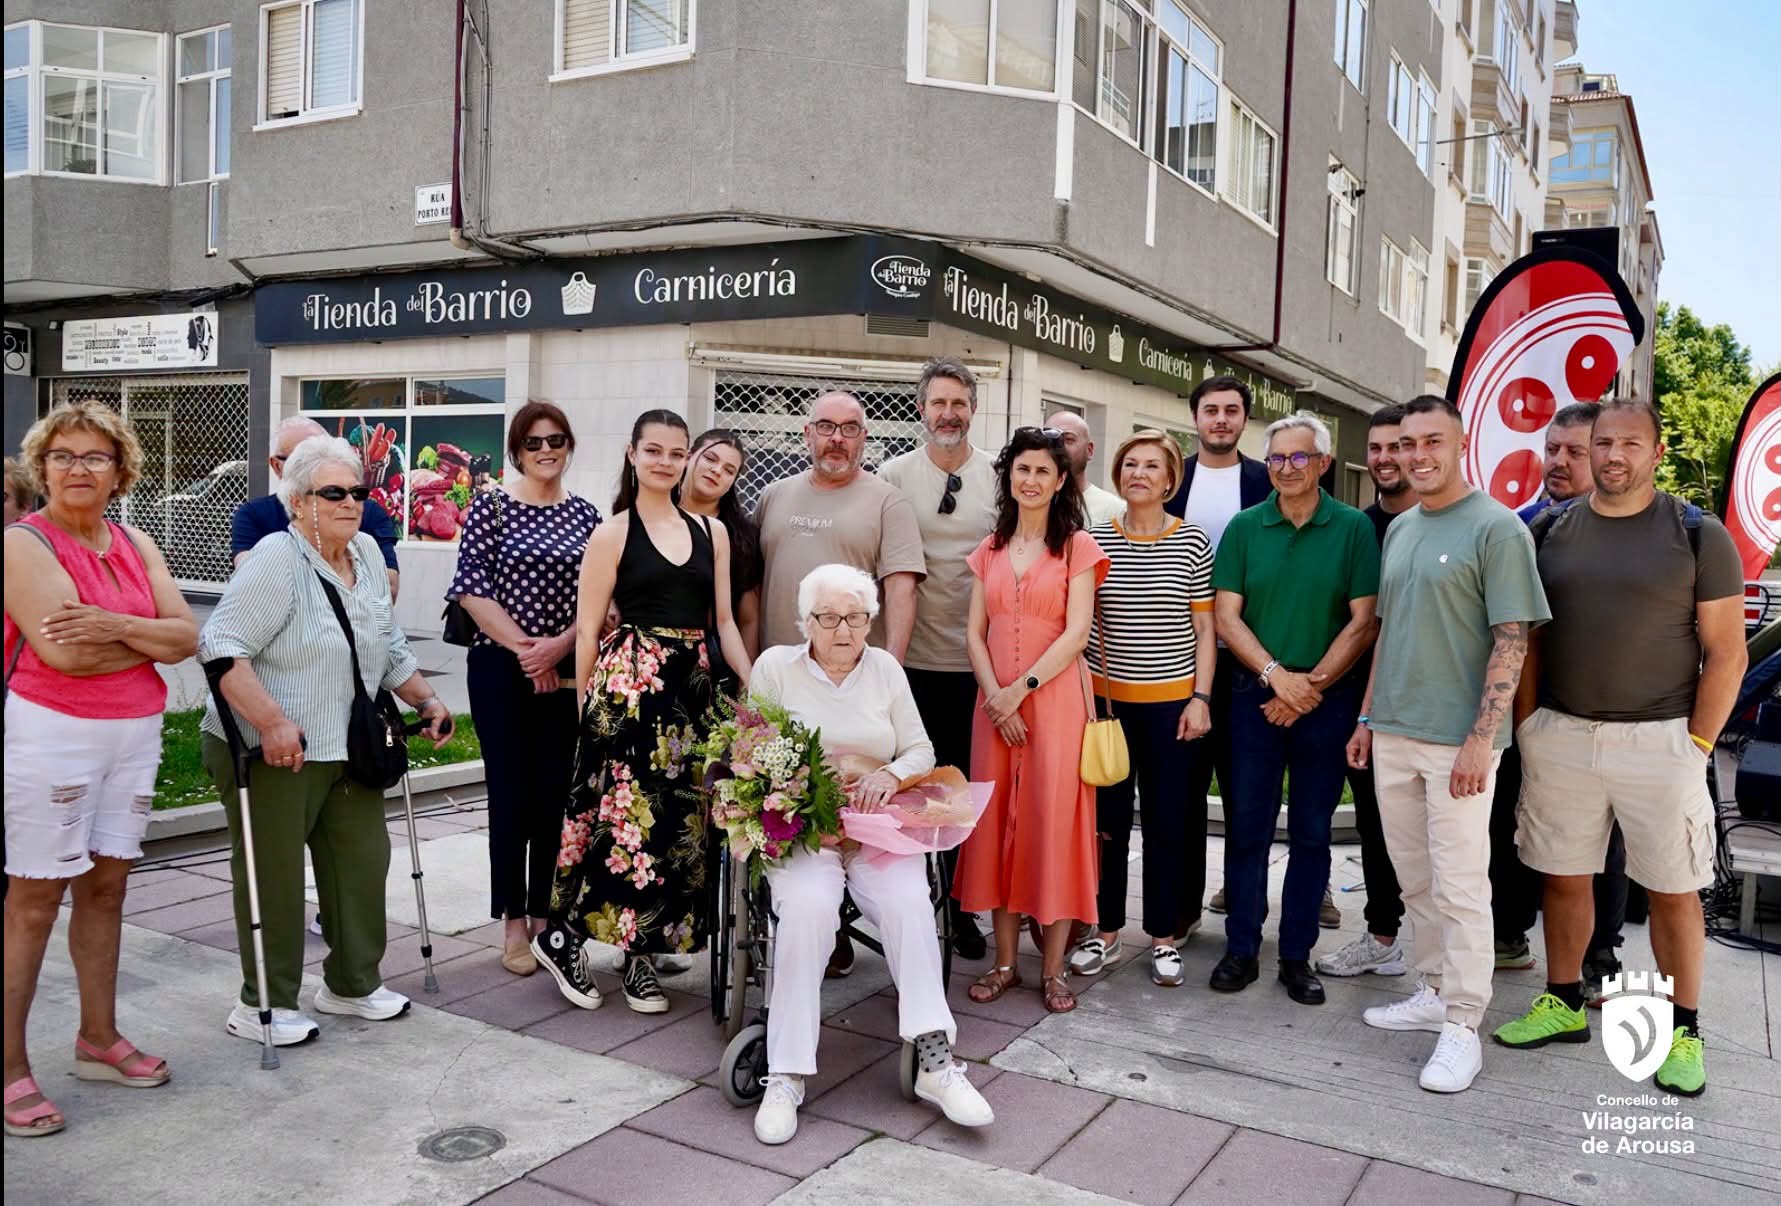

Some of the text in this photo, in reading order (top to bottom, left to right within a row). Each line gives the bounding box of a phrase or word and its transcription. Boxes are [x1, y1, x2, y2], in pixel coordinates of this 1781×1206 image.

[417, 206, 451, 219] PORTO RE
[634, 258, 796, 304] Carnicería
[883, 268, 927, 287] Barrio
[889, 260, 931, 278] Tienda
[303, 279, 532, 330] la Tienda del Barrio
[943, 266, 1096, 354] la Tienda del Barrio
[1138, 336, 1193, 382] Carnicería
[1263, 378, 1293, 414] Barrio
